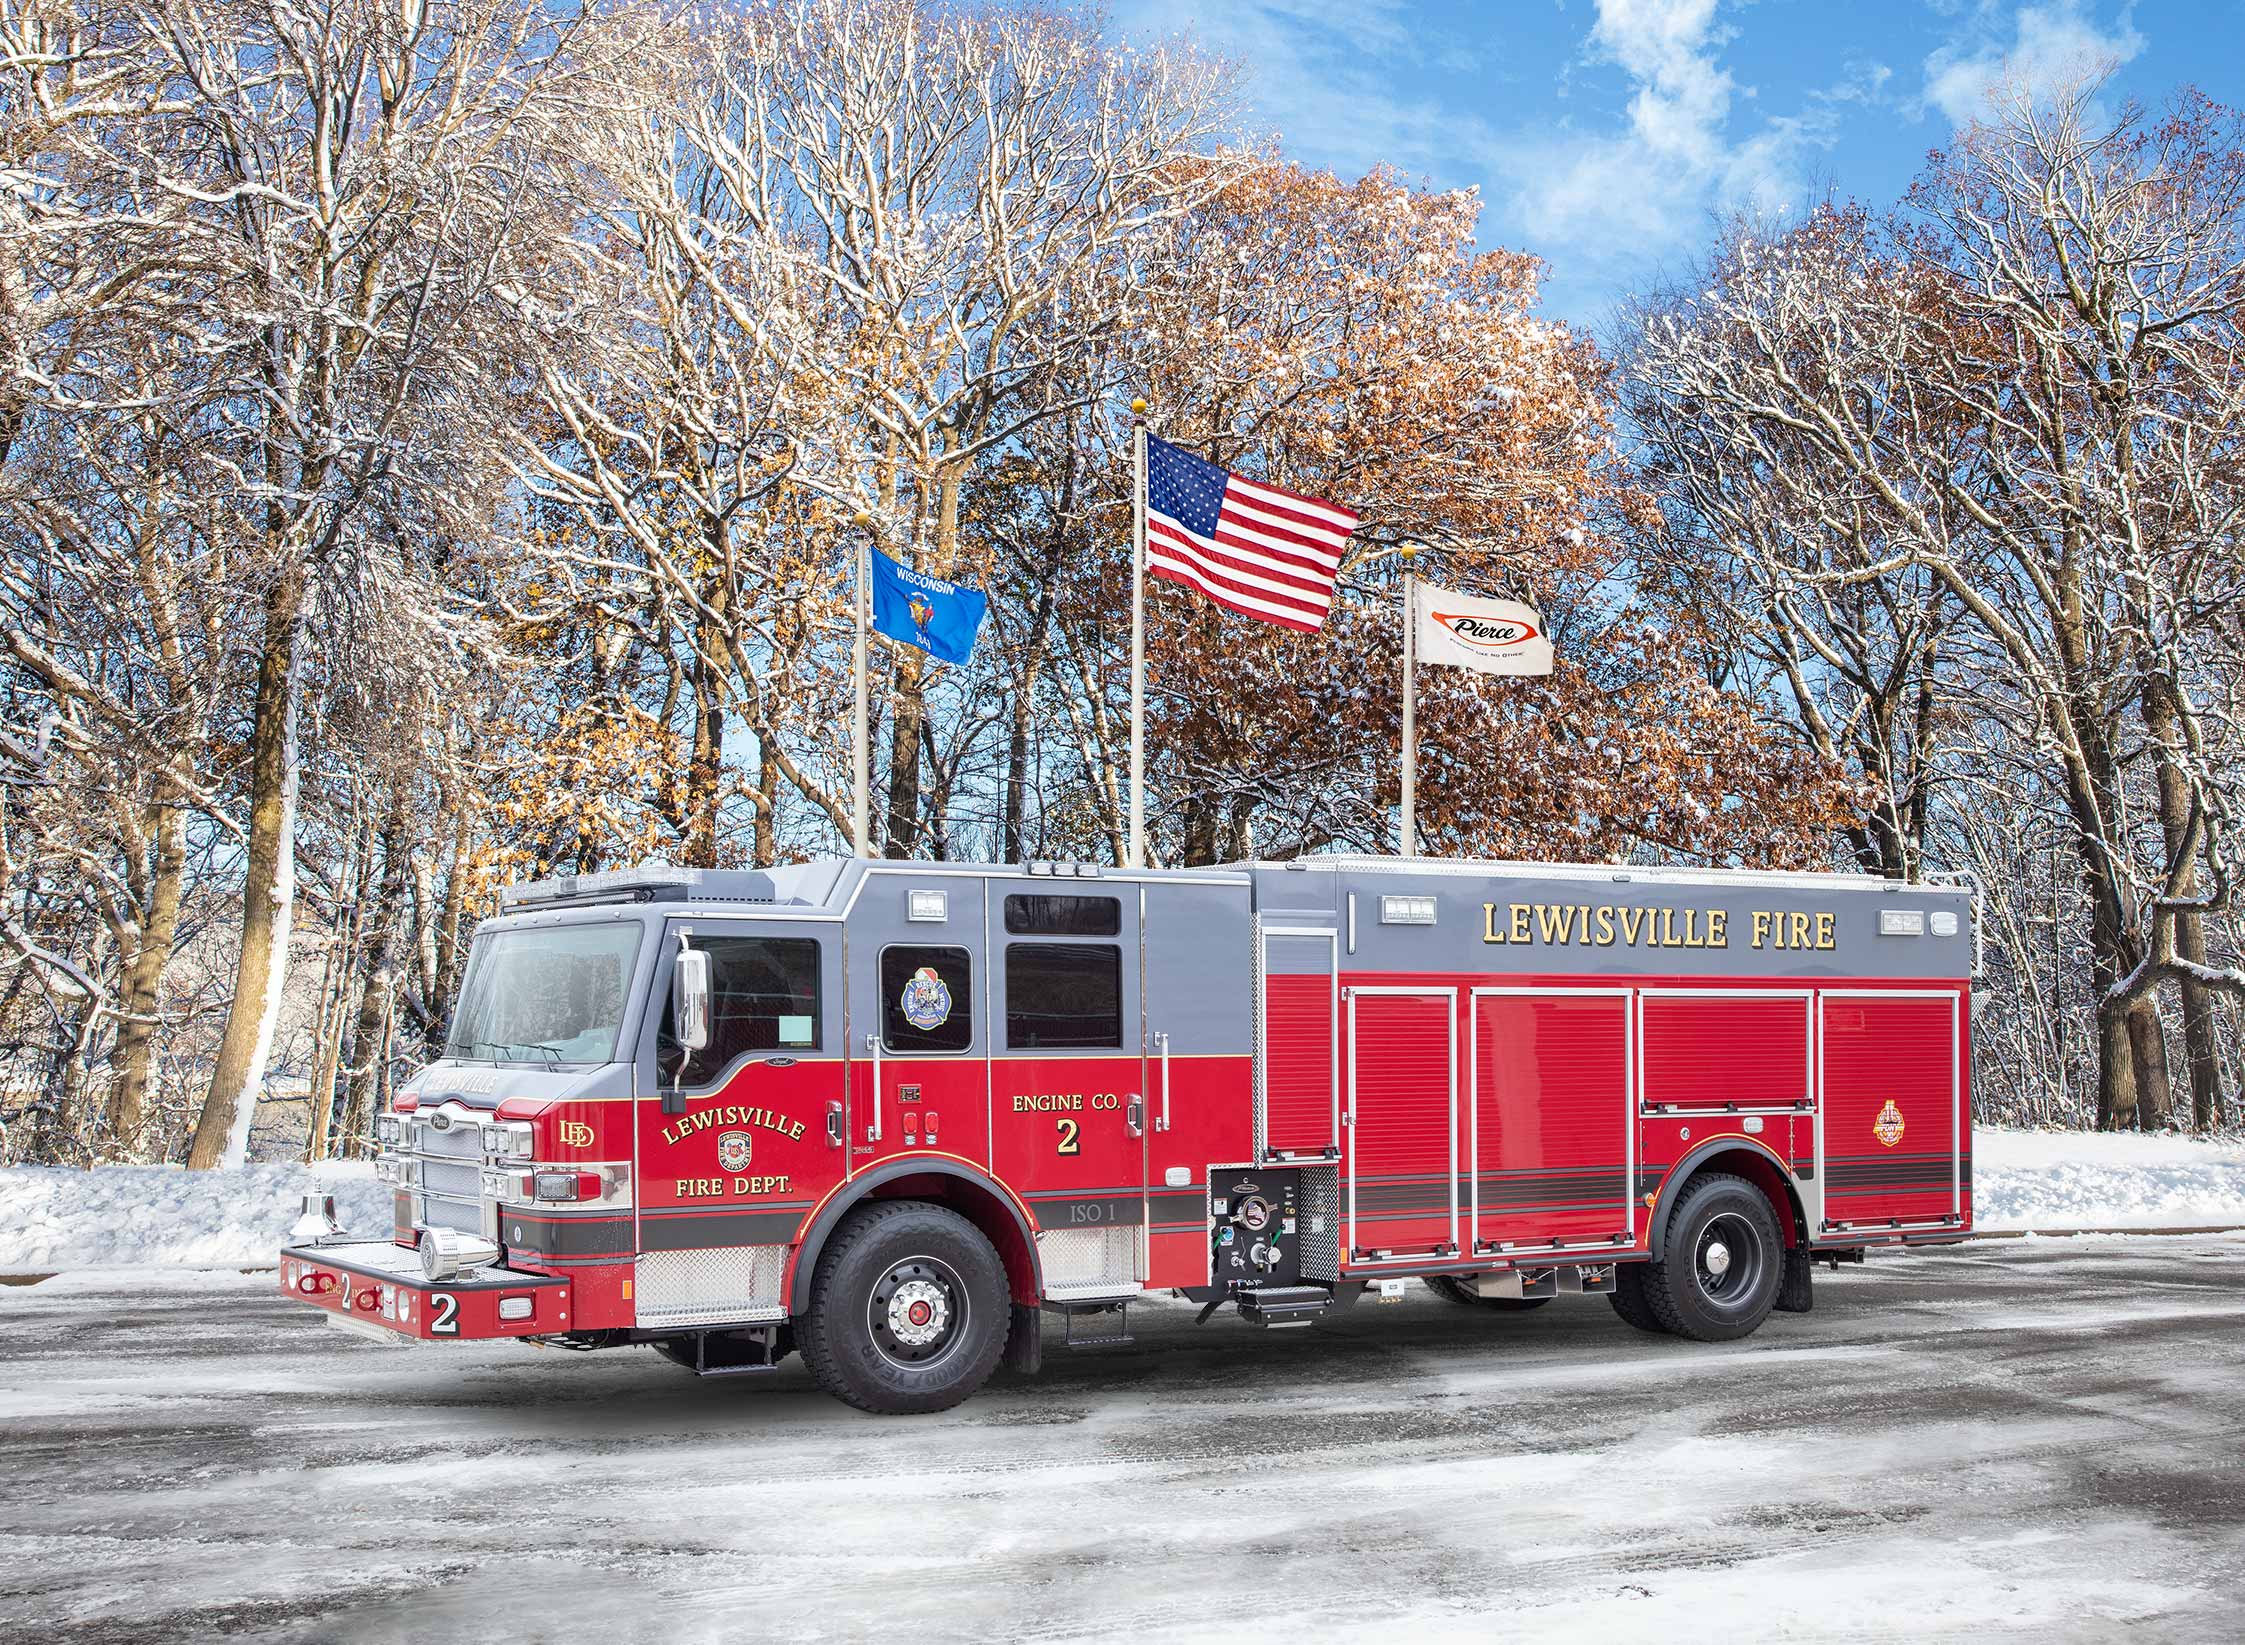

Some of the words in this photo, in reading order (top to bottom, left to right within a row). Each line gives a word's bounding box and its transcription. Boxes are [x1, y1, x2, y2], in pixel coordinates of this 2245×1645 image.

[896, 567, 956, 595] WISCONSIN
[1454, 618, 1515, 639] Pierce
[1484, 903, 1728, 948] LEWISVILLE
[1752, 911, 1836, 949] FIRE
[1013, 1095, 1083, 1112] ENGINE
[1091, 1094, 1121, 1110] CO.
[661, 1106, 806, 1145] LEWISVILLE
[1056, 1118, 1080, 1155] 2
[676, 1178, 723, 1198] FIRE
[734, 1176, 793, 1195] DEPT.
[1071, 1204, 1101, 1222] ISO
[1109, 1204, 1115, 1220] 1
[341, 1272, 351, 1311] 2
[431, 1292, 461, 1336] 2
